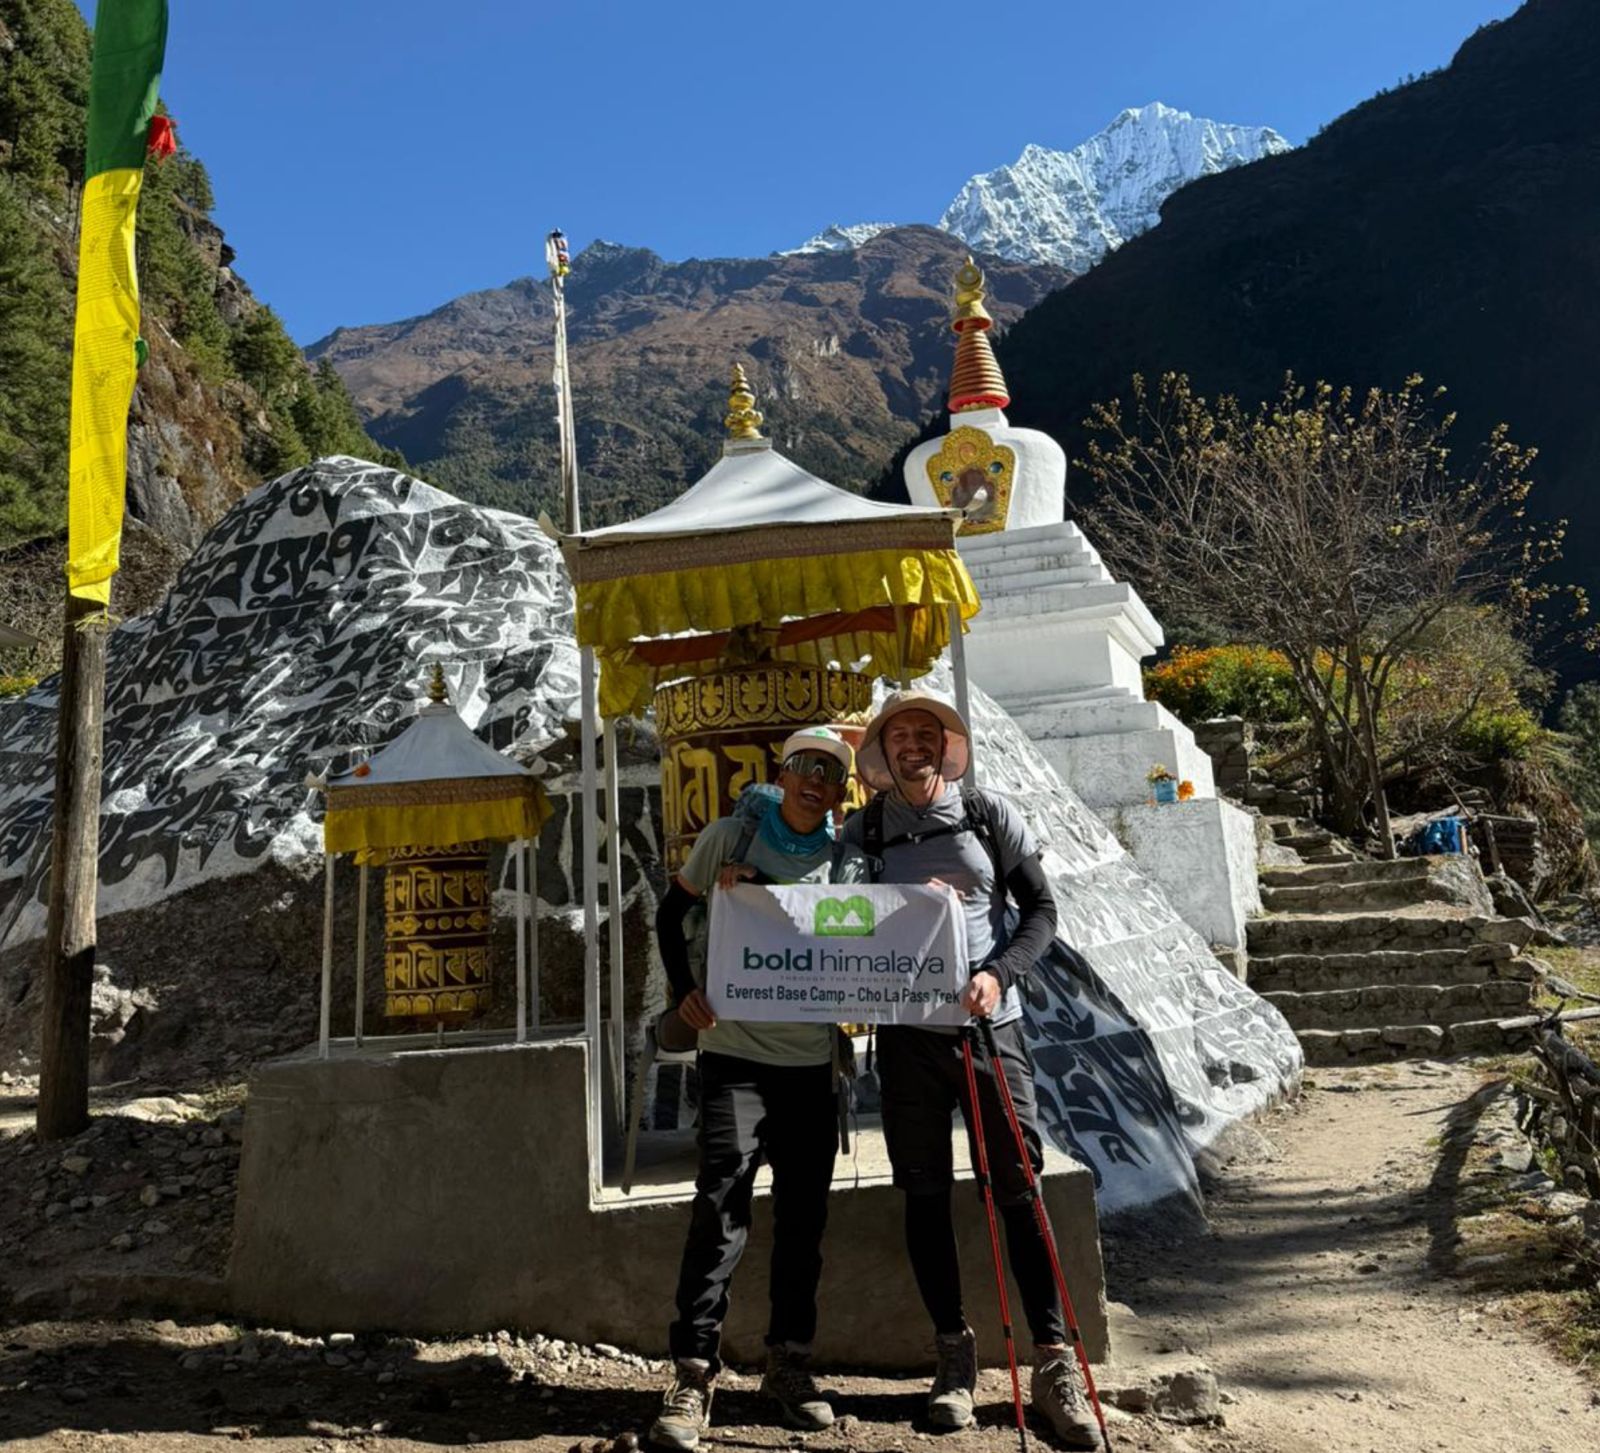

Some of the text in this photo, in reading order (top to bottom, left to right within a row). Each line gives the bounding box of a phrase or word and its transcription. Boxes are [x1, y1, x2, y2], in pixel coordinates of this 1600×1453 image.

[743, 946, 944, 980] bold himalaya
[726, 983, 774, 1000] Everest
[776, 985, 808, 1001] Base
[810, 986, 846, 1005] Camp
[857, 987, 882, 1003] Cho
[884, 987, 900, 1003] La
[902, 987, 931, 1004] Pass
[932, 988, 961, 1005] Trek
